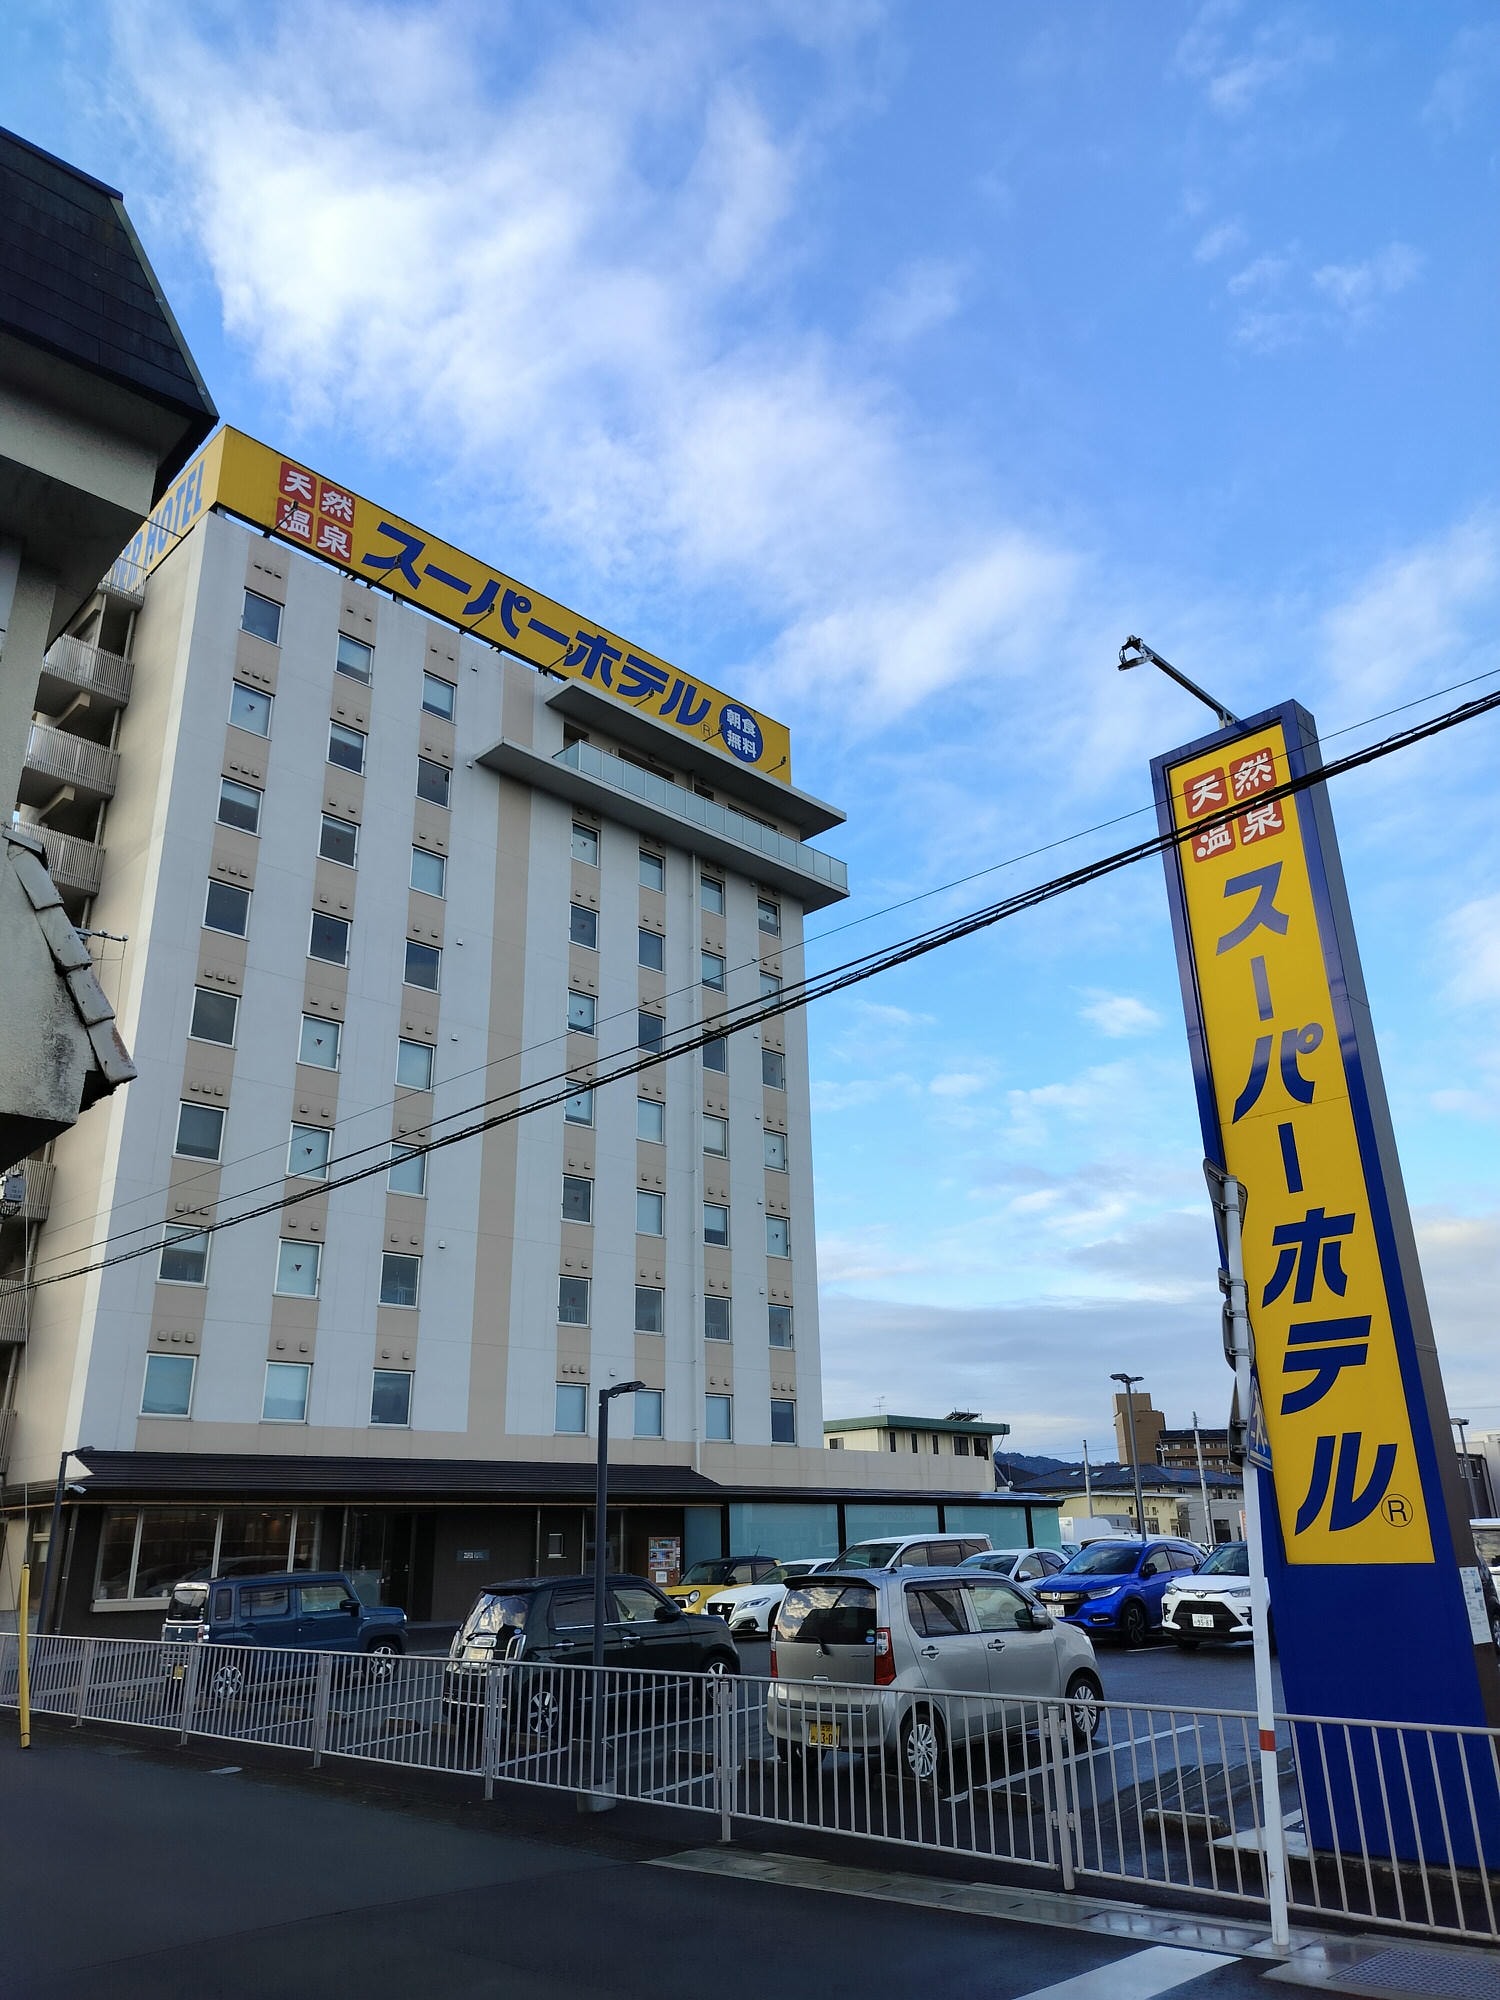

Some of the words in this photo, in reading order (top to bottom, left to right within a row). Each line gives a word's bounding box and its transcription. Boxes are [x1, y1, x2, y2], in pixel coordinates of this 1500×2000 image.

[143, 459, 205, 570] HOTEL
[284, 470, 353, 522] 天然
[279, 504, 351, 558] 温泉
[361, 521, 712, 726] スーパーホテル
[726, 709, 756, 737] 朝食
[727, 730, 757, 758] 無料
[1192, 752, 1272, 813] 天然
[1196, 800, 1283, 858] 温泉
[1215, 860, 1398, 1536] スーパーホテル
